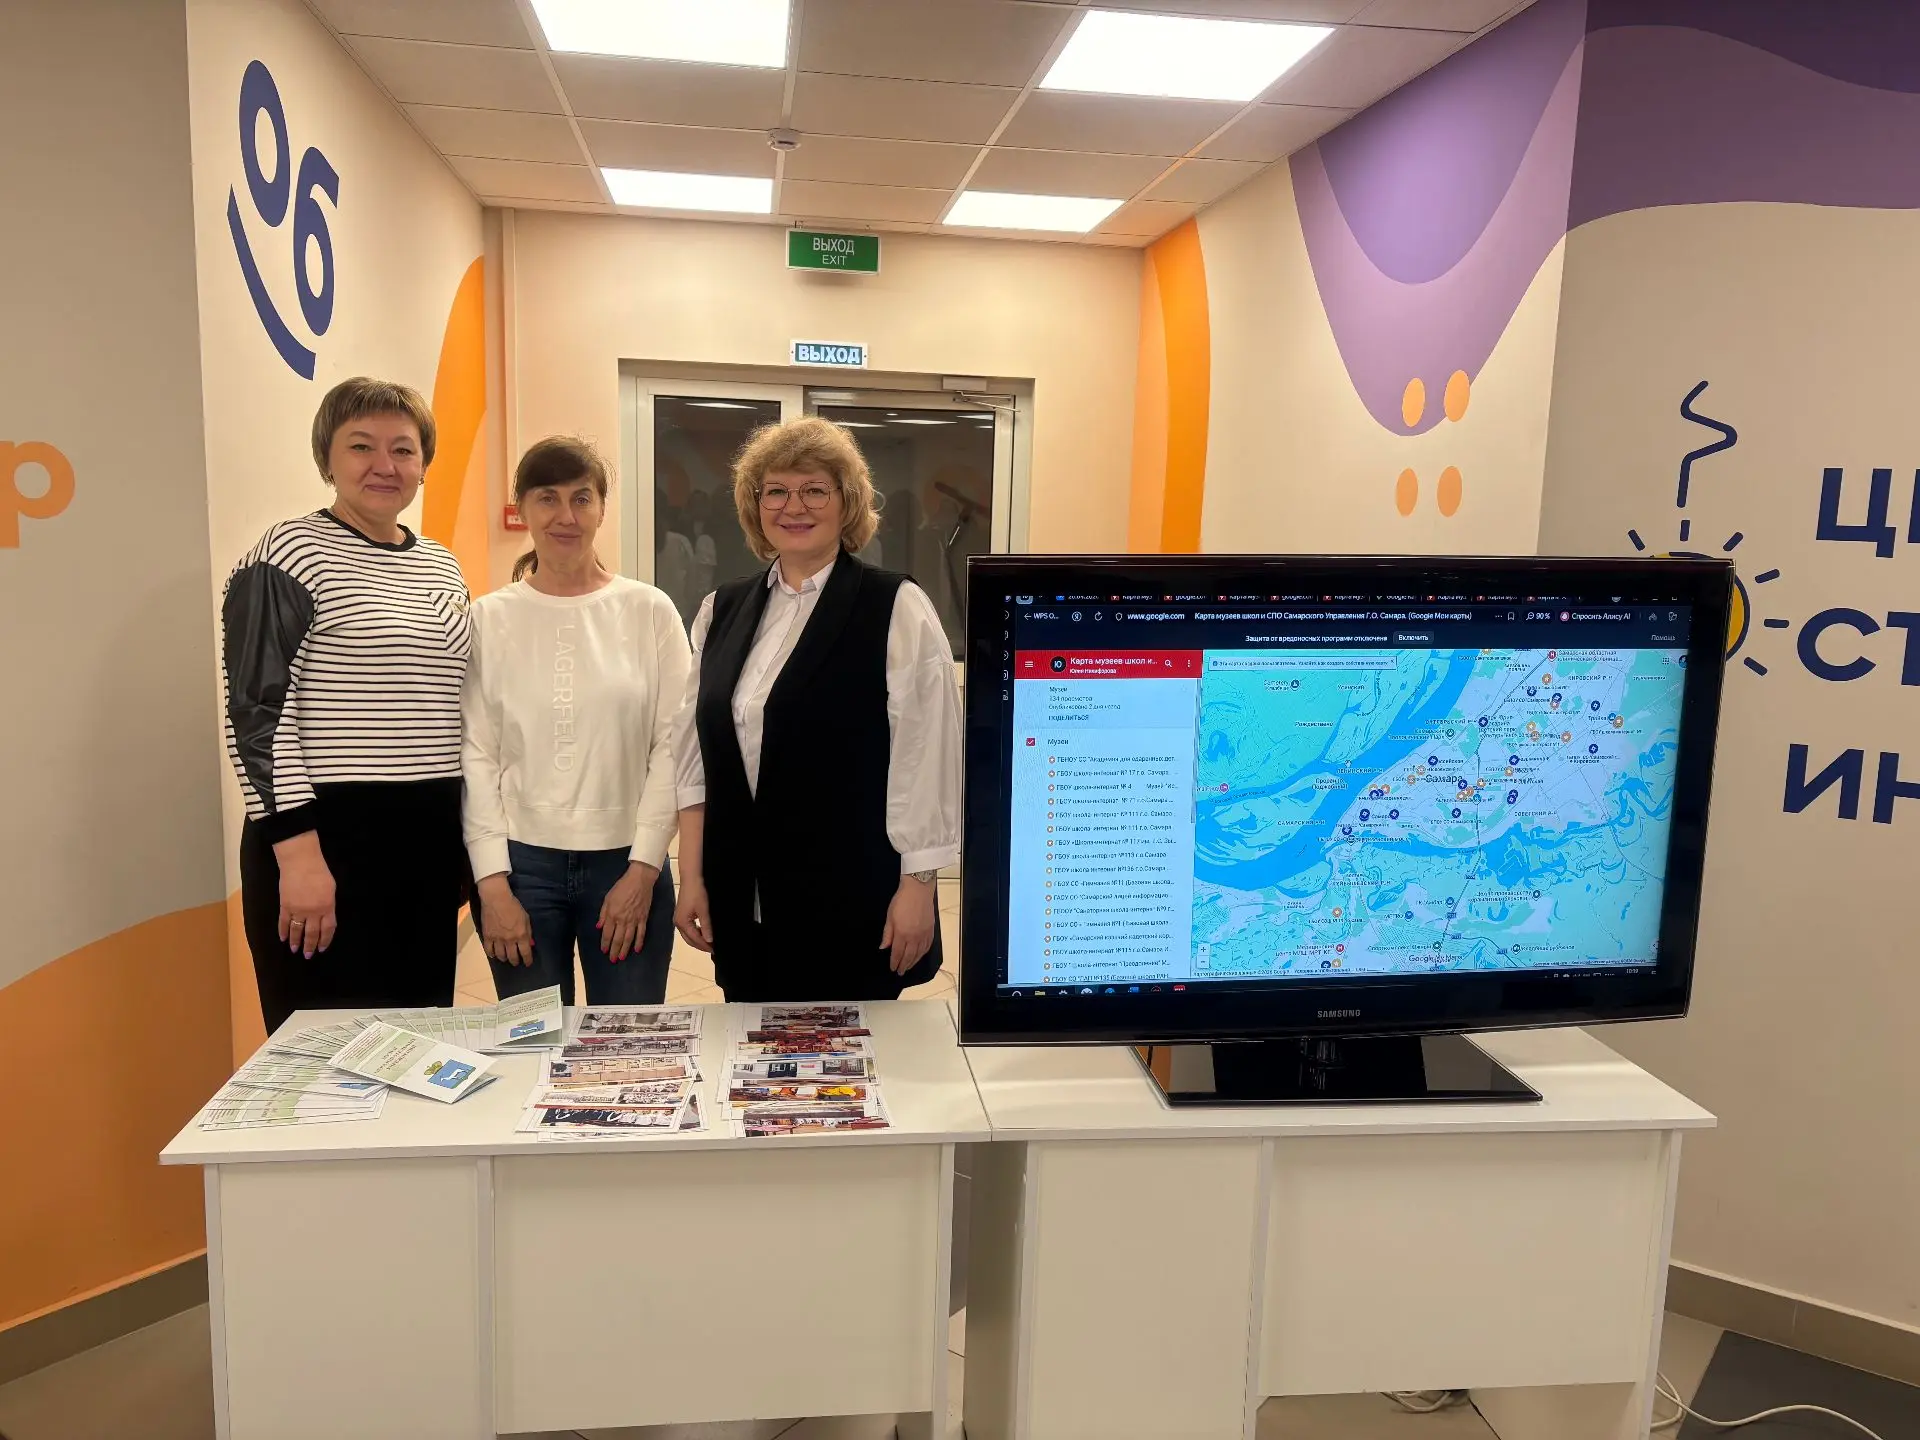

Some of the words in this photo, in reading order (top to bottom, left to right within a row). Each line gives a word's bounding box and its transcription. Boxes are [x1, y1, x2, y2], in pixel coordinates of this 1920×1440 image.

[812, 237, 855, 255] ВЫХОД
[822, 254, 847, 266] EXIT
[798, 345, 861, 364] ВЫХОД
[1816, 467, 1920, 559] Ц
[1033, 612, 1048, 620] WPS
[1127, 612, 1185, 621] www.google.com
[1194, 612, 1215, 621] Карта
[1215, 613, 1241, 621] музеев
[1266, 612, 1283, 620] СПО
[1283, 612, 1325, 621] Самарского
[1325, 612, 1365, 621] Управления
[1408, 612, 1434, 621] (Google
[1434, 612, 1450, 620] Мои
[1449, 612, 1473, 621] карты)
[1571, 612, 1602, 621] Спросить
[1603, 612, 1623, 621] Алису
[1245, 635, 1270, 643] Защита
[1398, 634, 1429, 642] Включить
[1070, 657, 1093, 667] Карта
[1094, 659, 1123, 667] музеев
[551, 625, 577, 773] LAGERFELD
[1425, 774, 1464, 786] Самара
[1317, 1009, 1362, 1019] SAMSUNG
